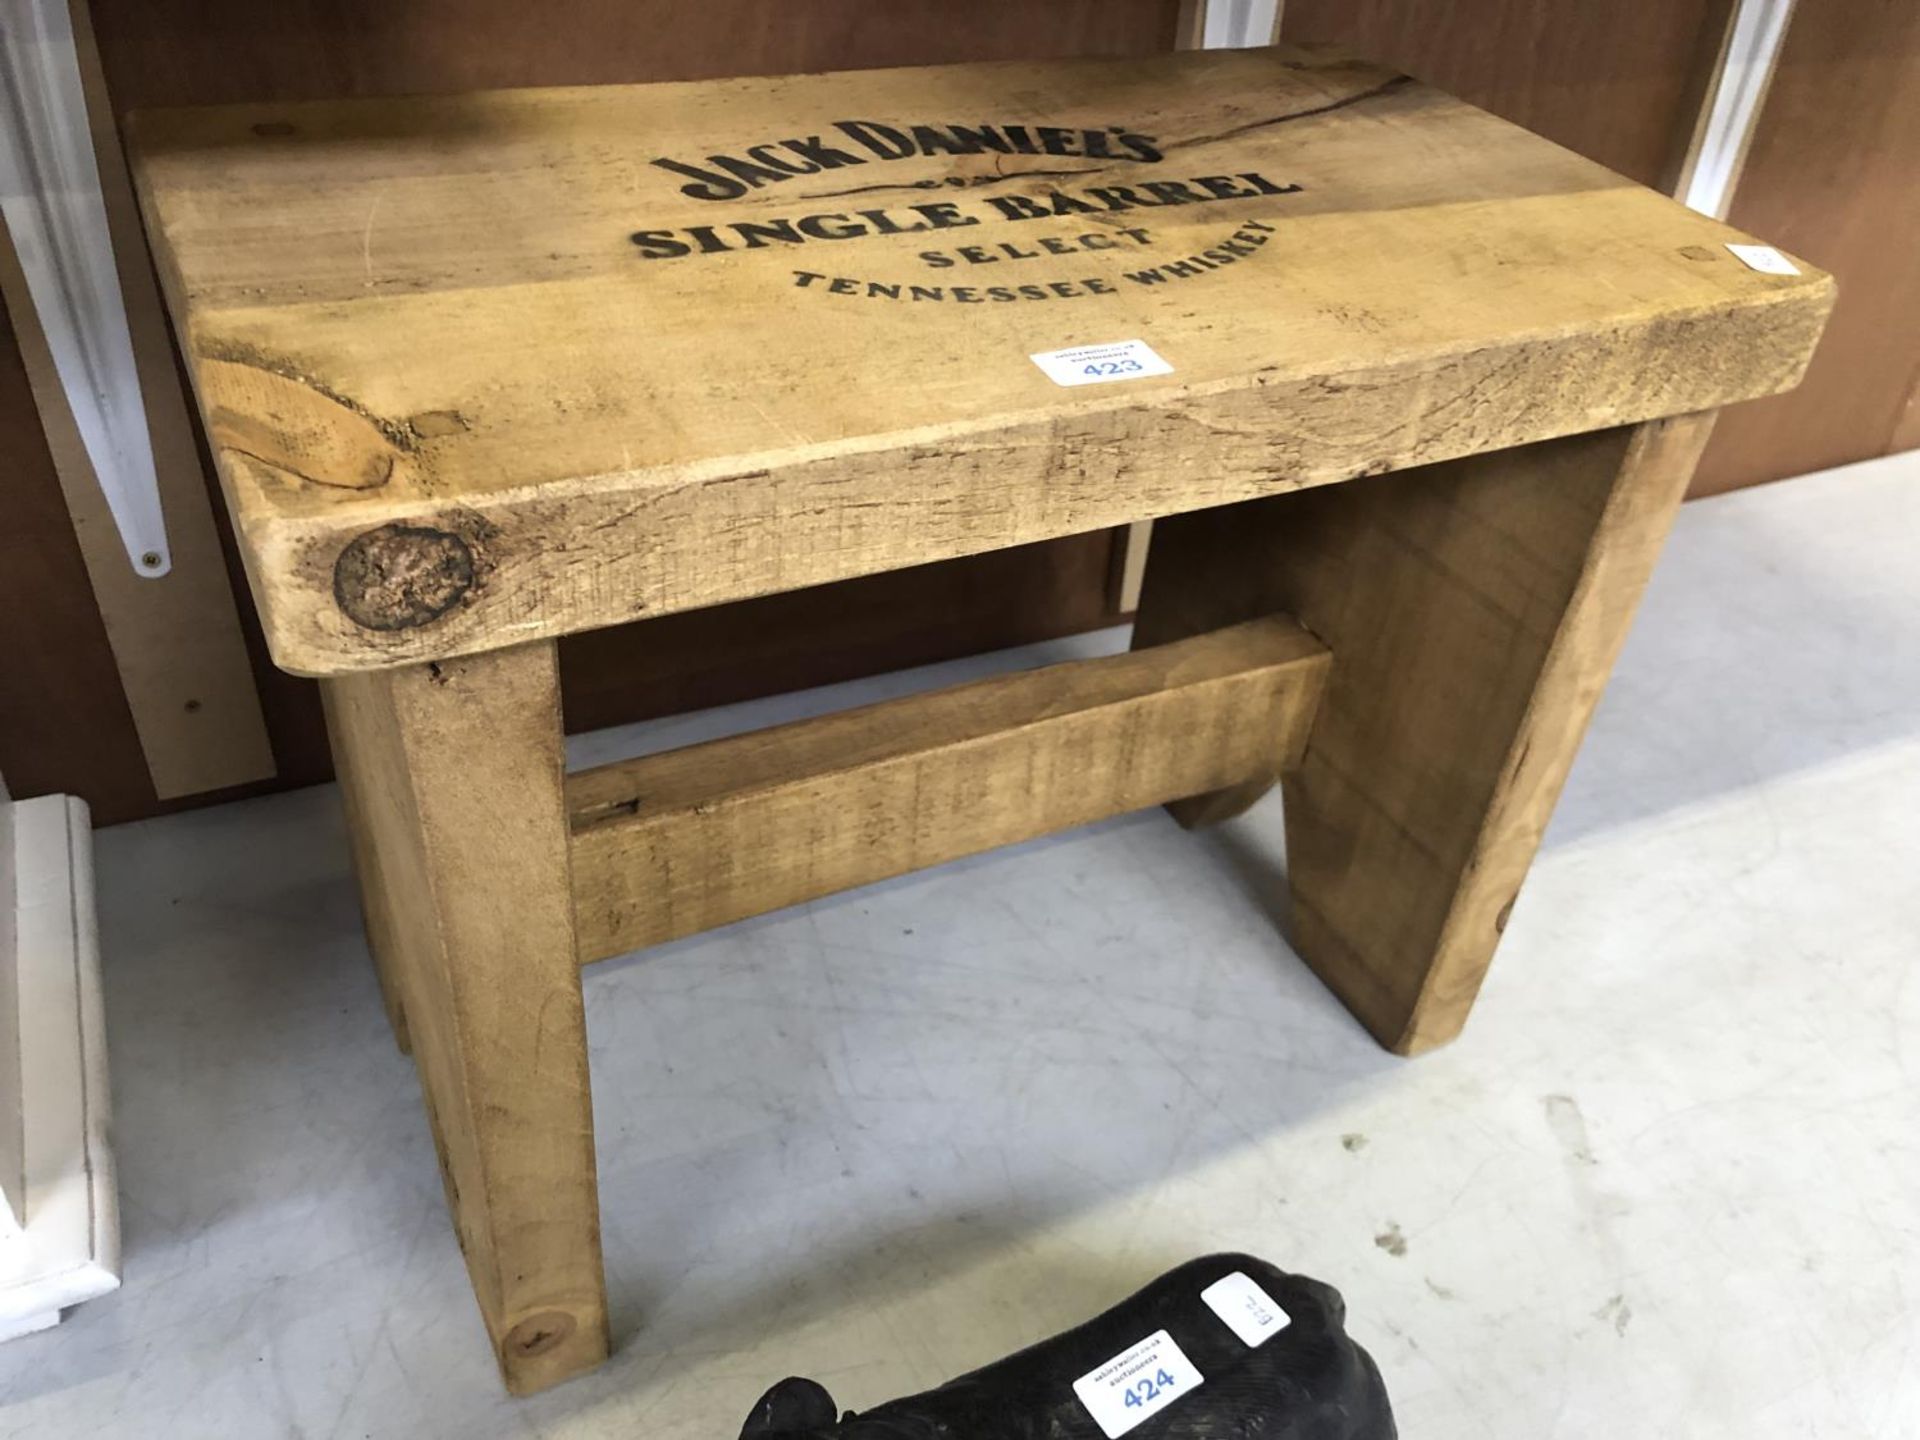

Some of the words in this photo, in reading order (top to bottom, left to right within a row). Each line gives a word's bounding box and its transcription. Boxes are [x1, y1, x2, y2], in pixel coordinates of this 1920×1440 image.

[650, 136, 869, 201] JACK
[832, 120, 1164, 163] DANIEL'S
[630, 202, 981, 259] SINGLE
[983, 173, 1304, 220] BARREL
[792, 270, 1118, 304] TENNESSEE
[1122, 219, 1276, 286] WHISKEY
[919, 228, 1153, 268] SELECT
[1083, 359, 1143, 375] 423
[1124, 1368, 1175, 1408] 424
